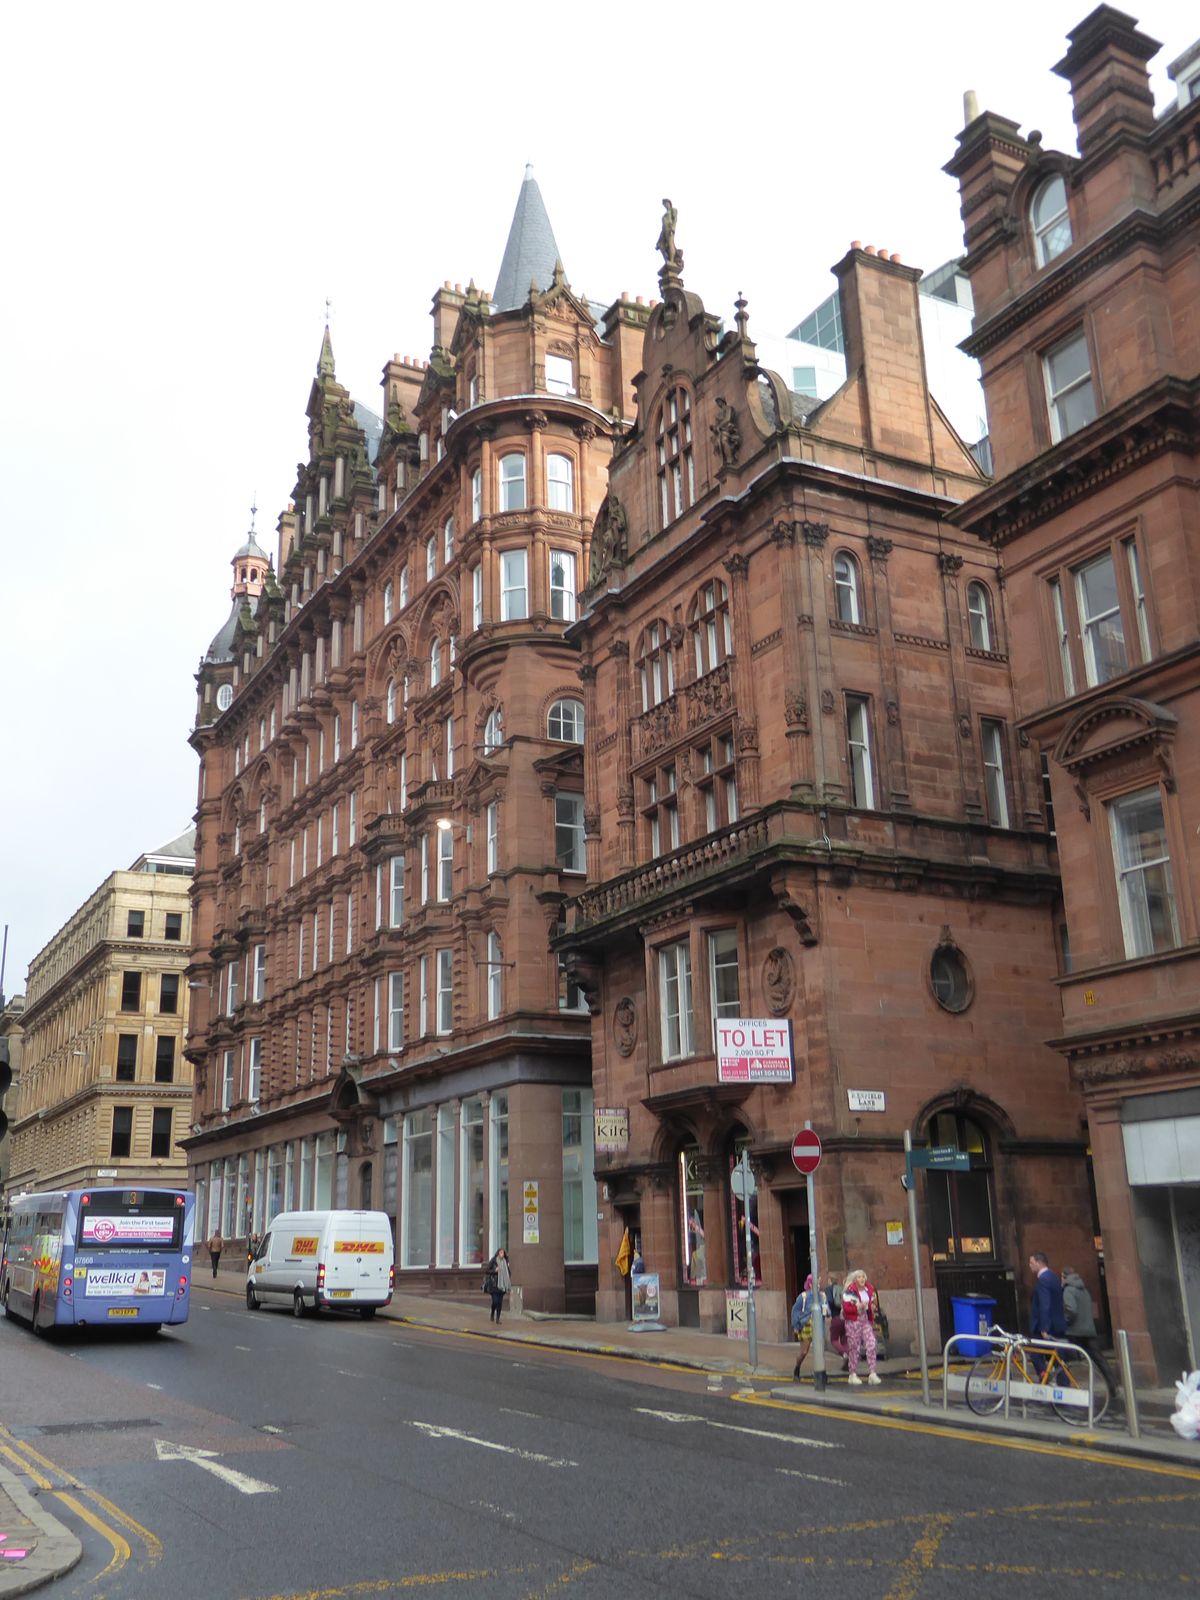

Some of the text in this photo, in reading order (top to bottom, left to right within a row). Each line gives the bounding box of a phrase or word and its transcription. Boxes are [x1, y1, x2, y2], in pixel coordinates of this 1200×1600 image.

[719, 1029, 787, 1047] TO LET
[129, 1191, 137, 1205] 3
[295, 1240, 314, 1253] DHL
[341, 1242, 378, 1252] DHL
[89, 1272, 136, 1284] wellkid
